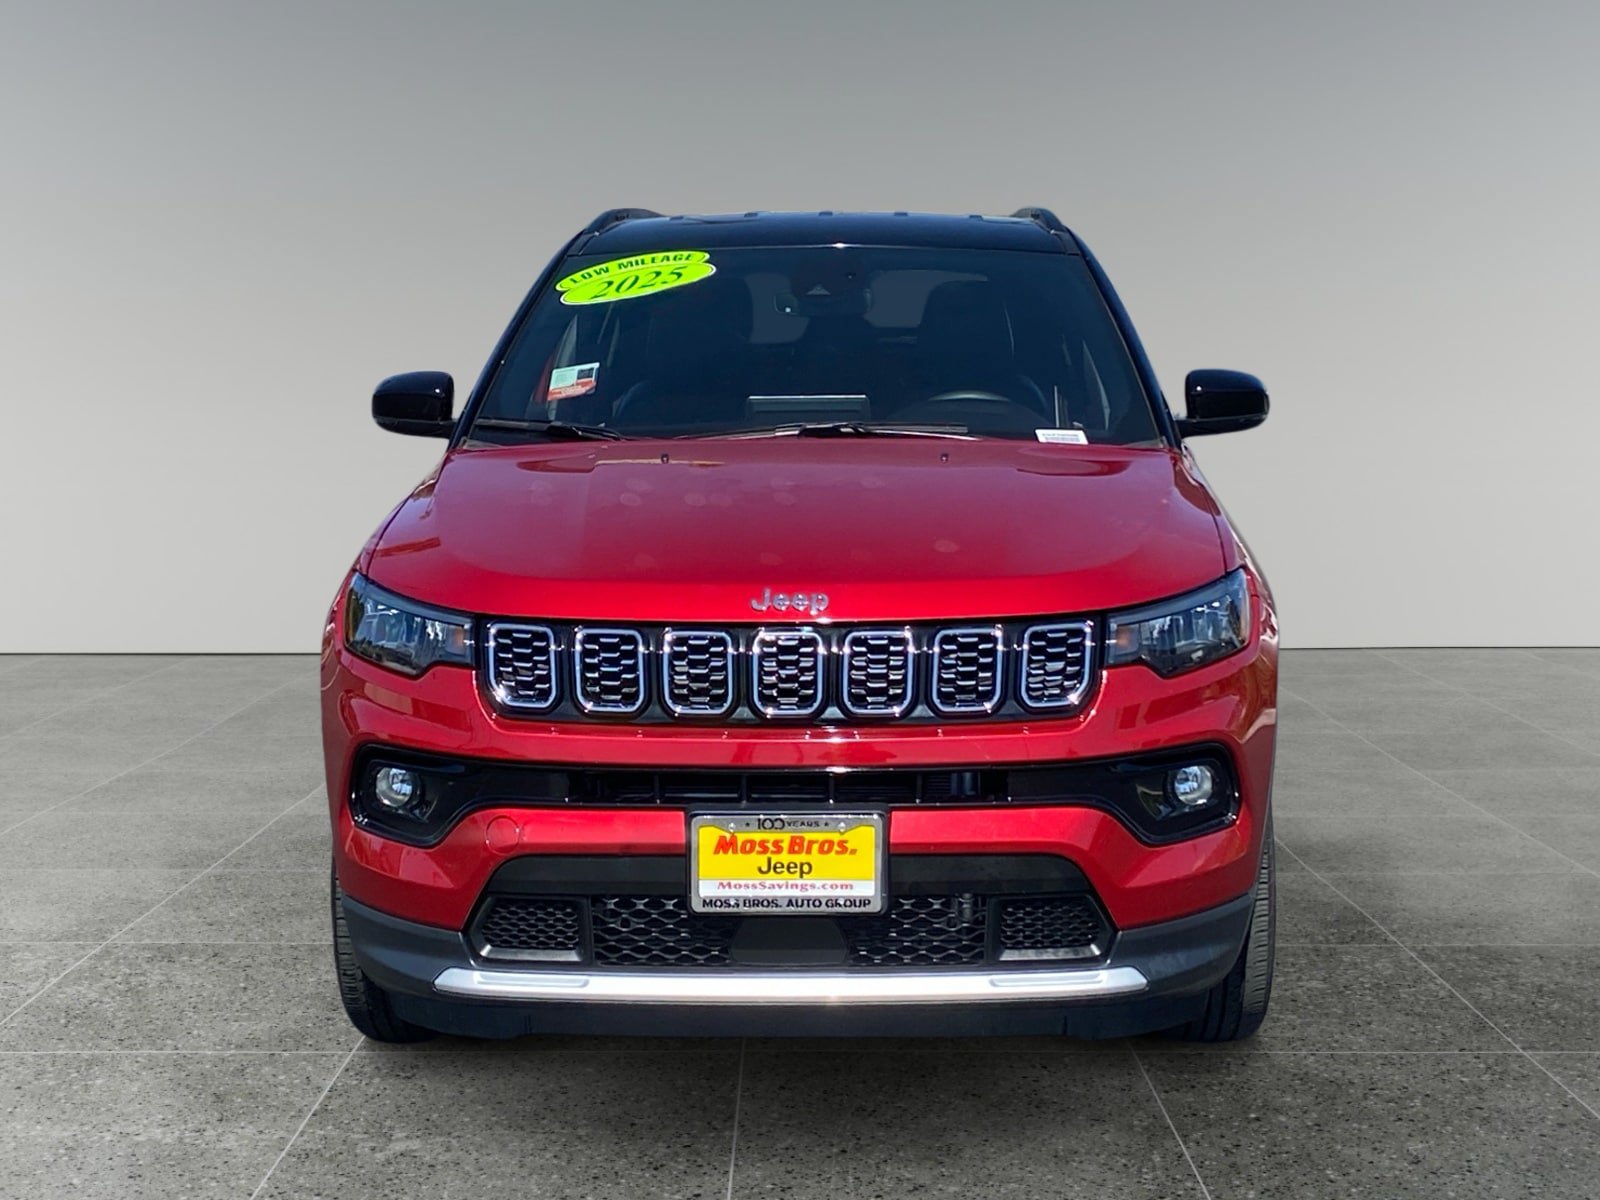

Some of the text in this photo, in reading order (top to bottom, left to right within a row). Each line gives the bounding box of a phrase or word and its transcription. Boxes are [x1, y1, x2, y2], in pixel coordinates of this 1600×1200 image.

[570, 252, 694, 284] LOW MILEAGE
[590, 265, 689, 300] 2025
[751, 587, 829, 616] Jeep
[786, 820, 820, 828] YEARS
[713, 834, 858, 855] Moss Bros.
[757, 857, 813, 879] Jeep
[717, 881, 854, 892] MossSavings.com
[702, 898, 872, 909] MOSS BROS. AUTO GROUP
